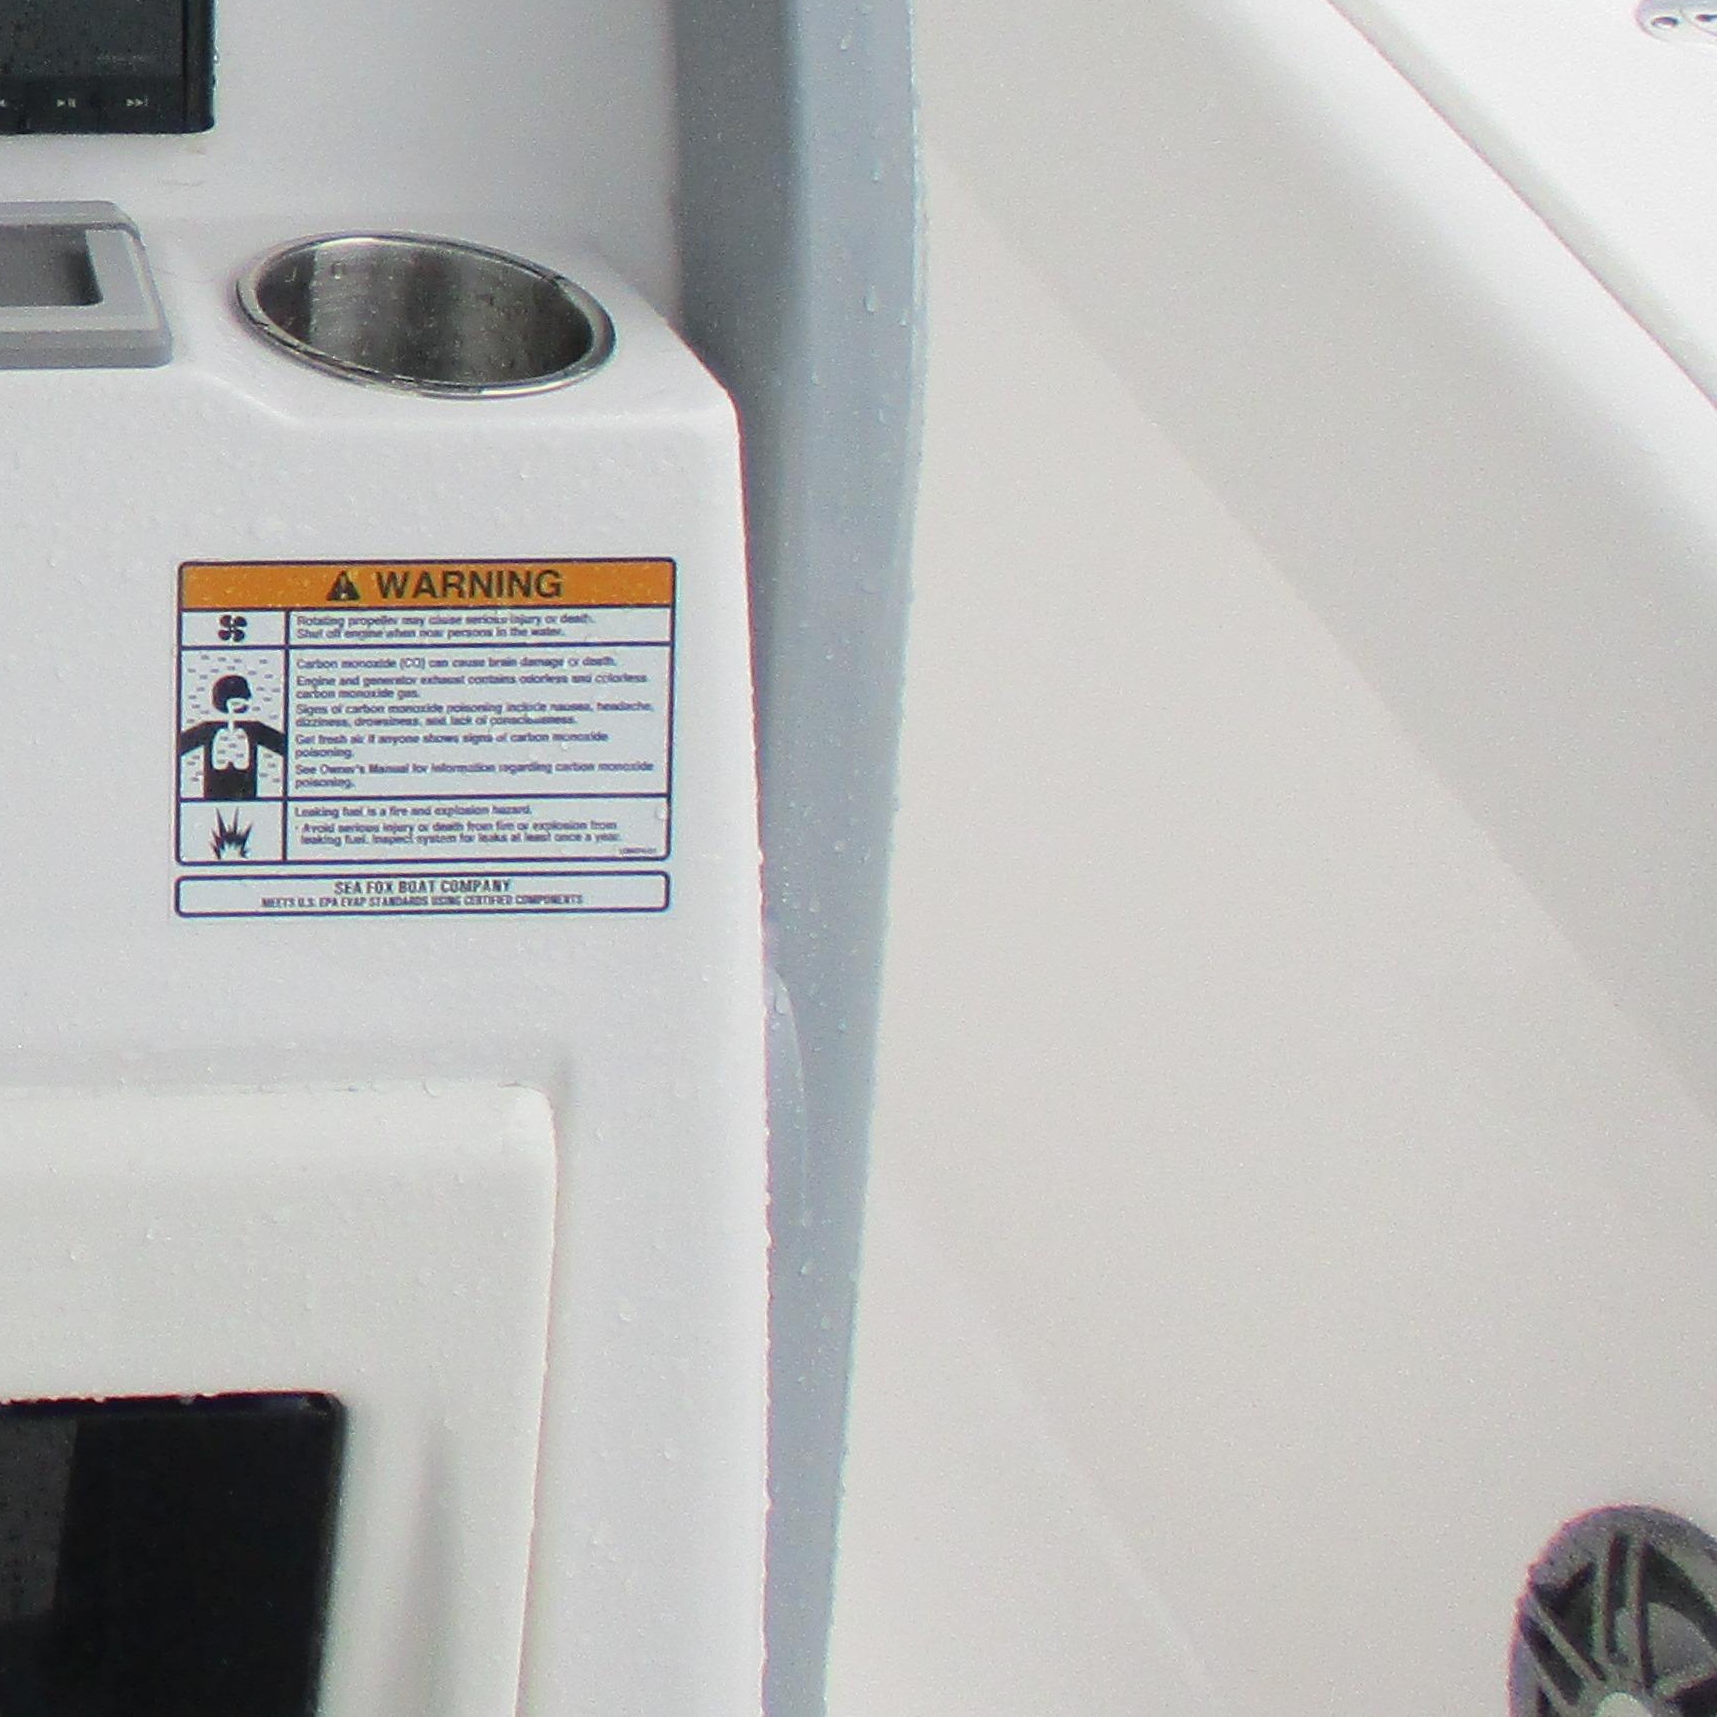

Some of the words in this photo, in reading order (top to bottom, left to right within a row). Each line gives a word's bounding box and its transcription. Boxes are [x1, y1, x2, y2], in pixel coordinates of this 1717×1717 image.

[376, 569, 564, 600] WARNING
[334, 880, 361, 894] SEA
[366, 880, 392, 894] FOX
[398, 880, 434, 893] BOAT
[440, 879, 511, 893] COMPANY
